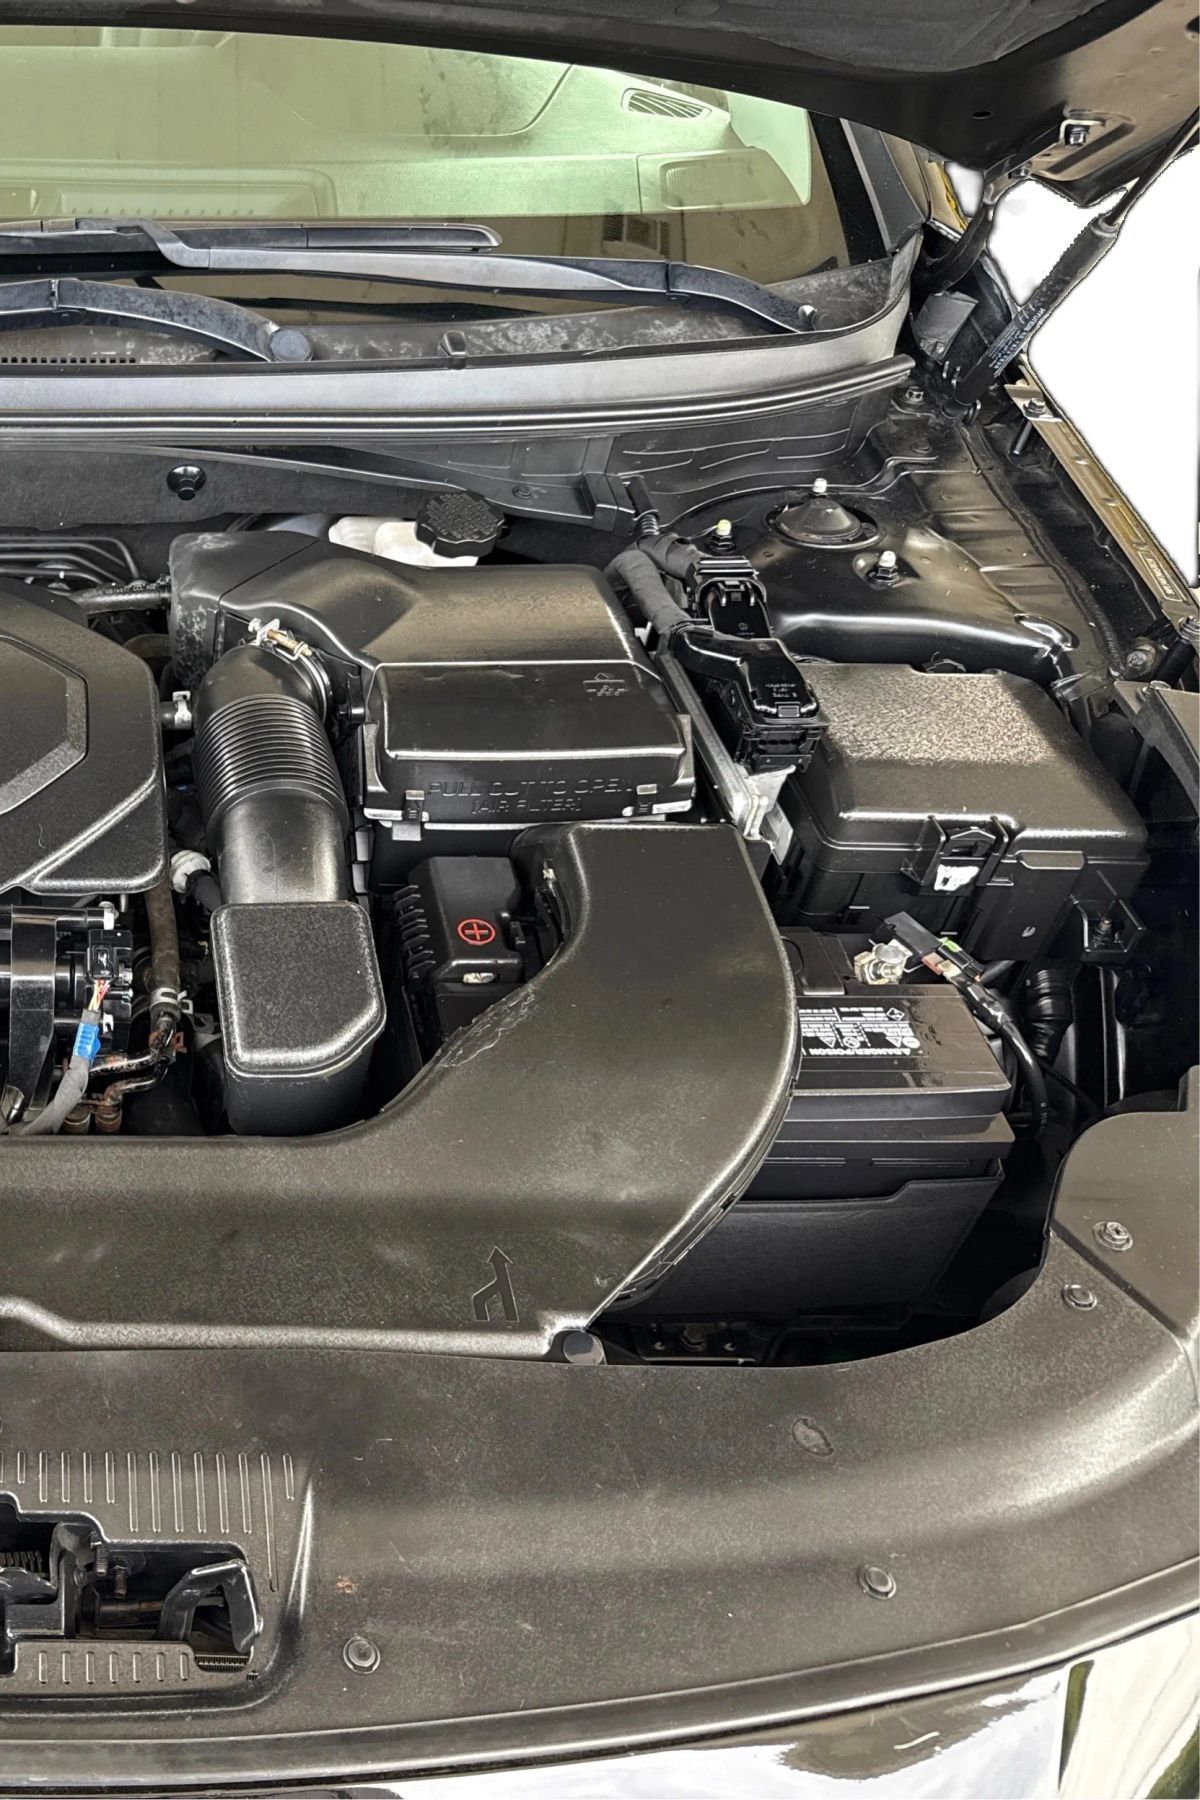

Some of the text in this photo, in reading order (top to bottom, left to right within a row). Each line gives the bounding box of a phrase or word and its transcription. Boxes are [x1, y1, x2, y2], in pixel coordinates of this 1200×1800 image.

[428, 778, 634, 797] PULL OUT TO OPEN
